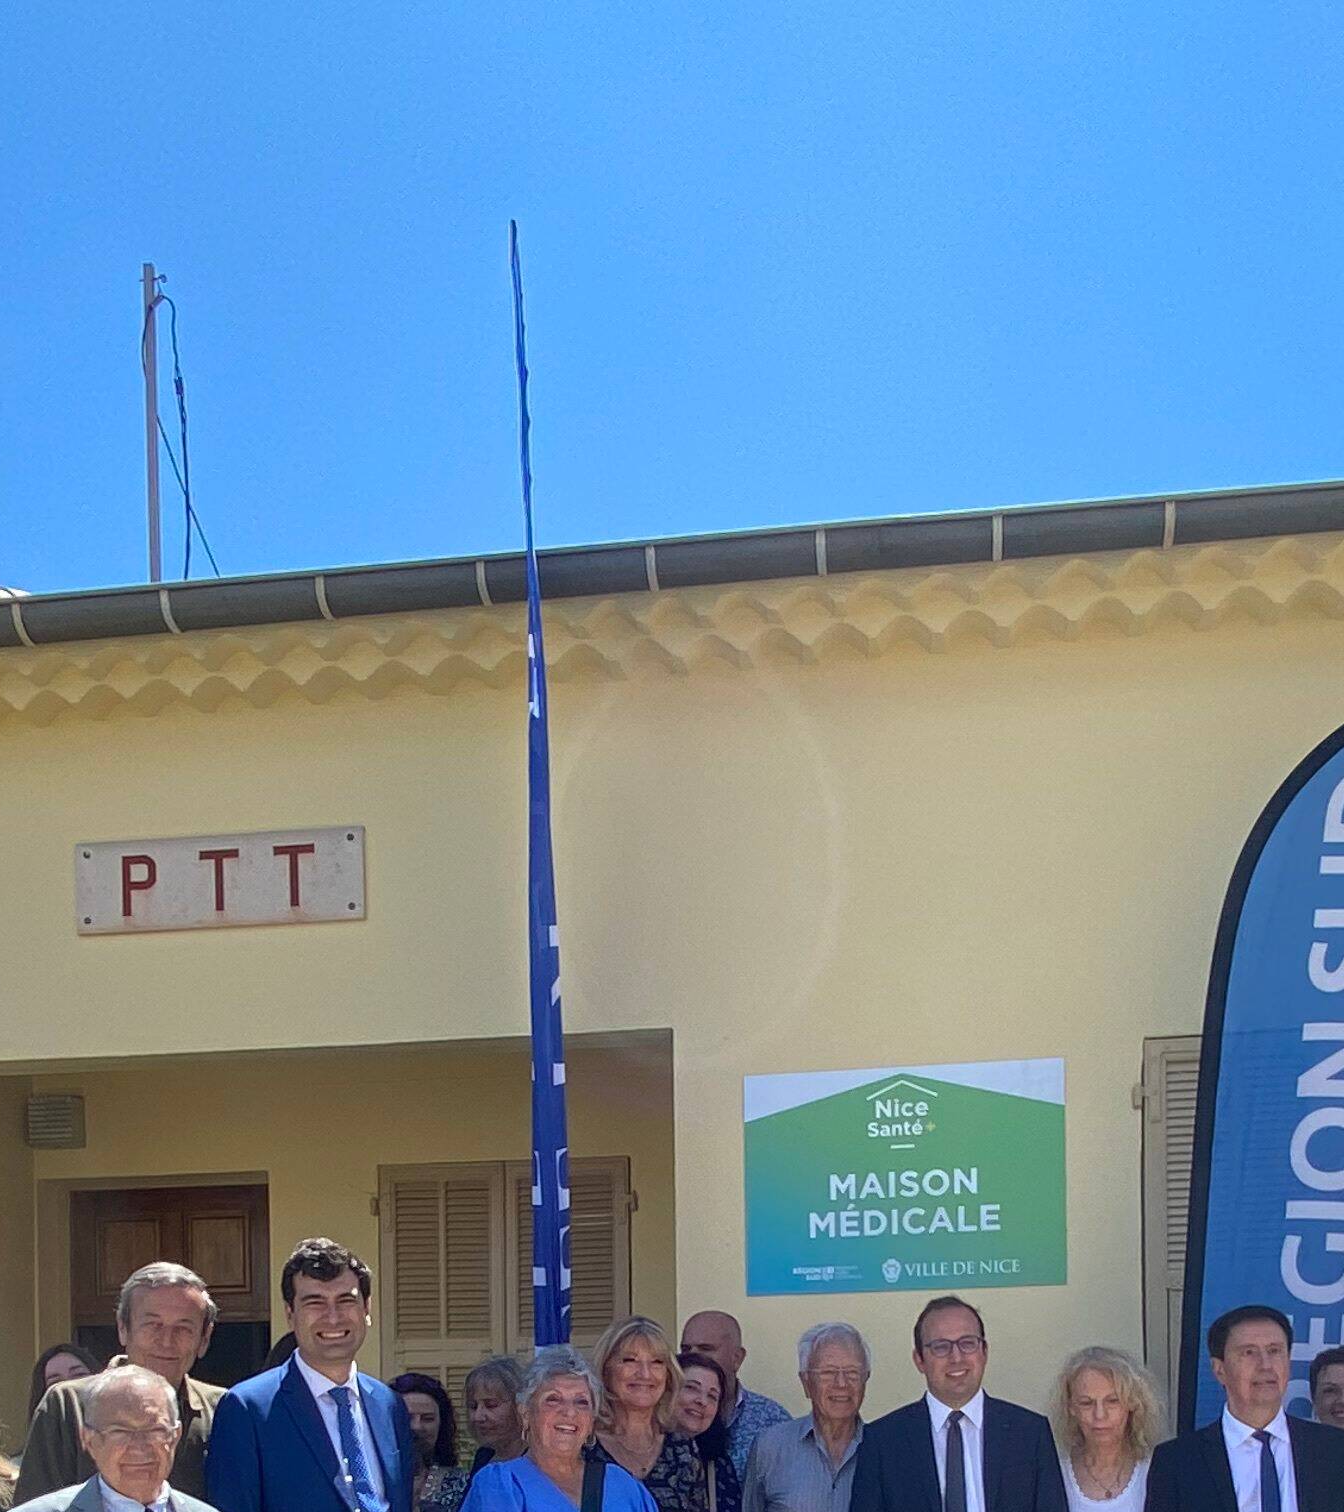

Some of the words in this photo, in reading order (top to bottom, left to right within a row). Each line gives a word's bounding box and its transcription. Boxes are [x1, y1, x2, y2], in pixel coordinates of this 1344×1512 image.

[875, 1098, 929, 1119] Nice
[829, 1166, 979, 1201] MAISON
[808, 1203, 1002, 1239] MÉDICALE
[904, 1261, 949, 1277] VILLE
[953, 1260, 975, 1276] DE
[979, 1258, 1022, 1275] NICE
